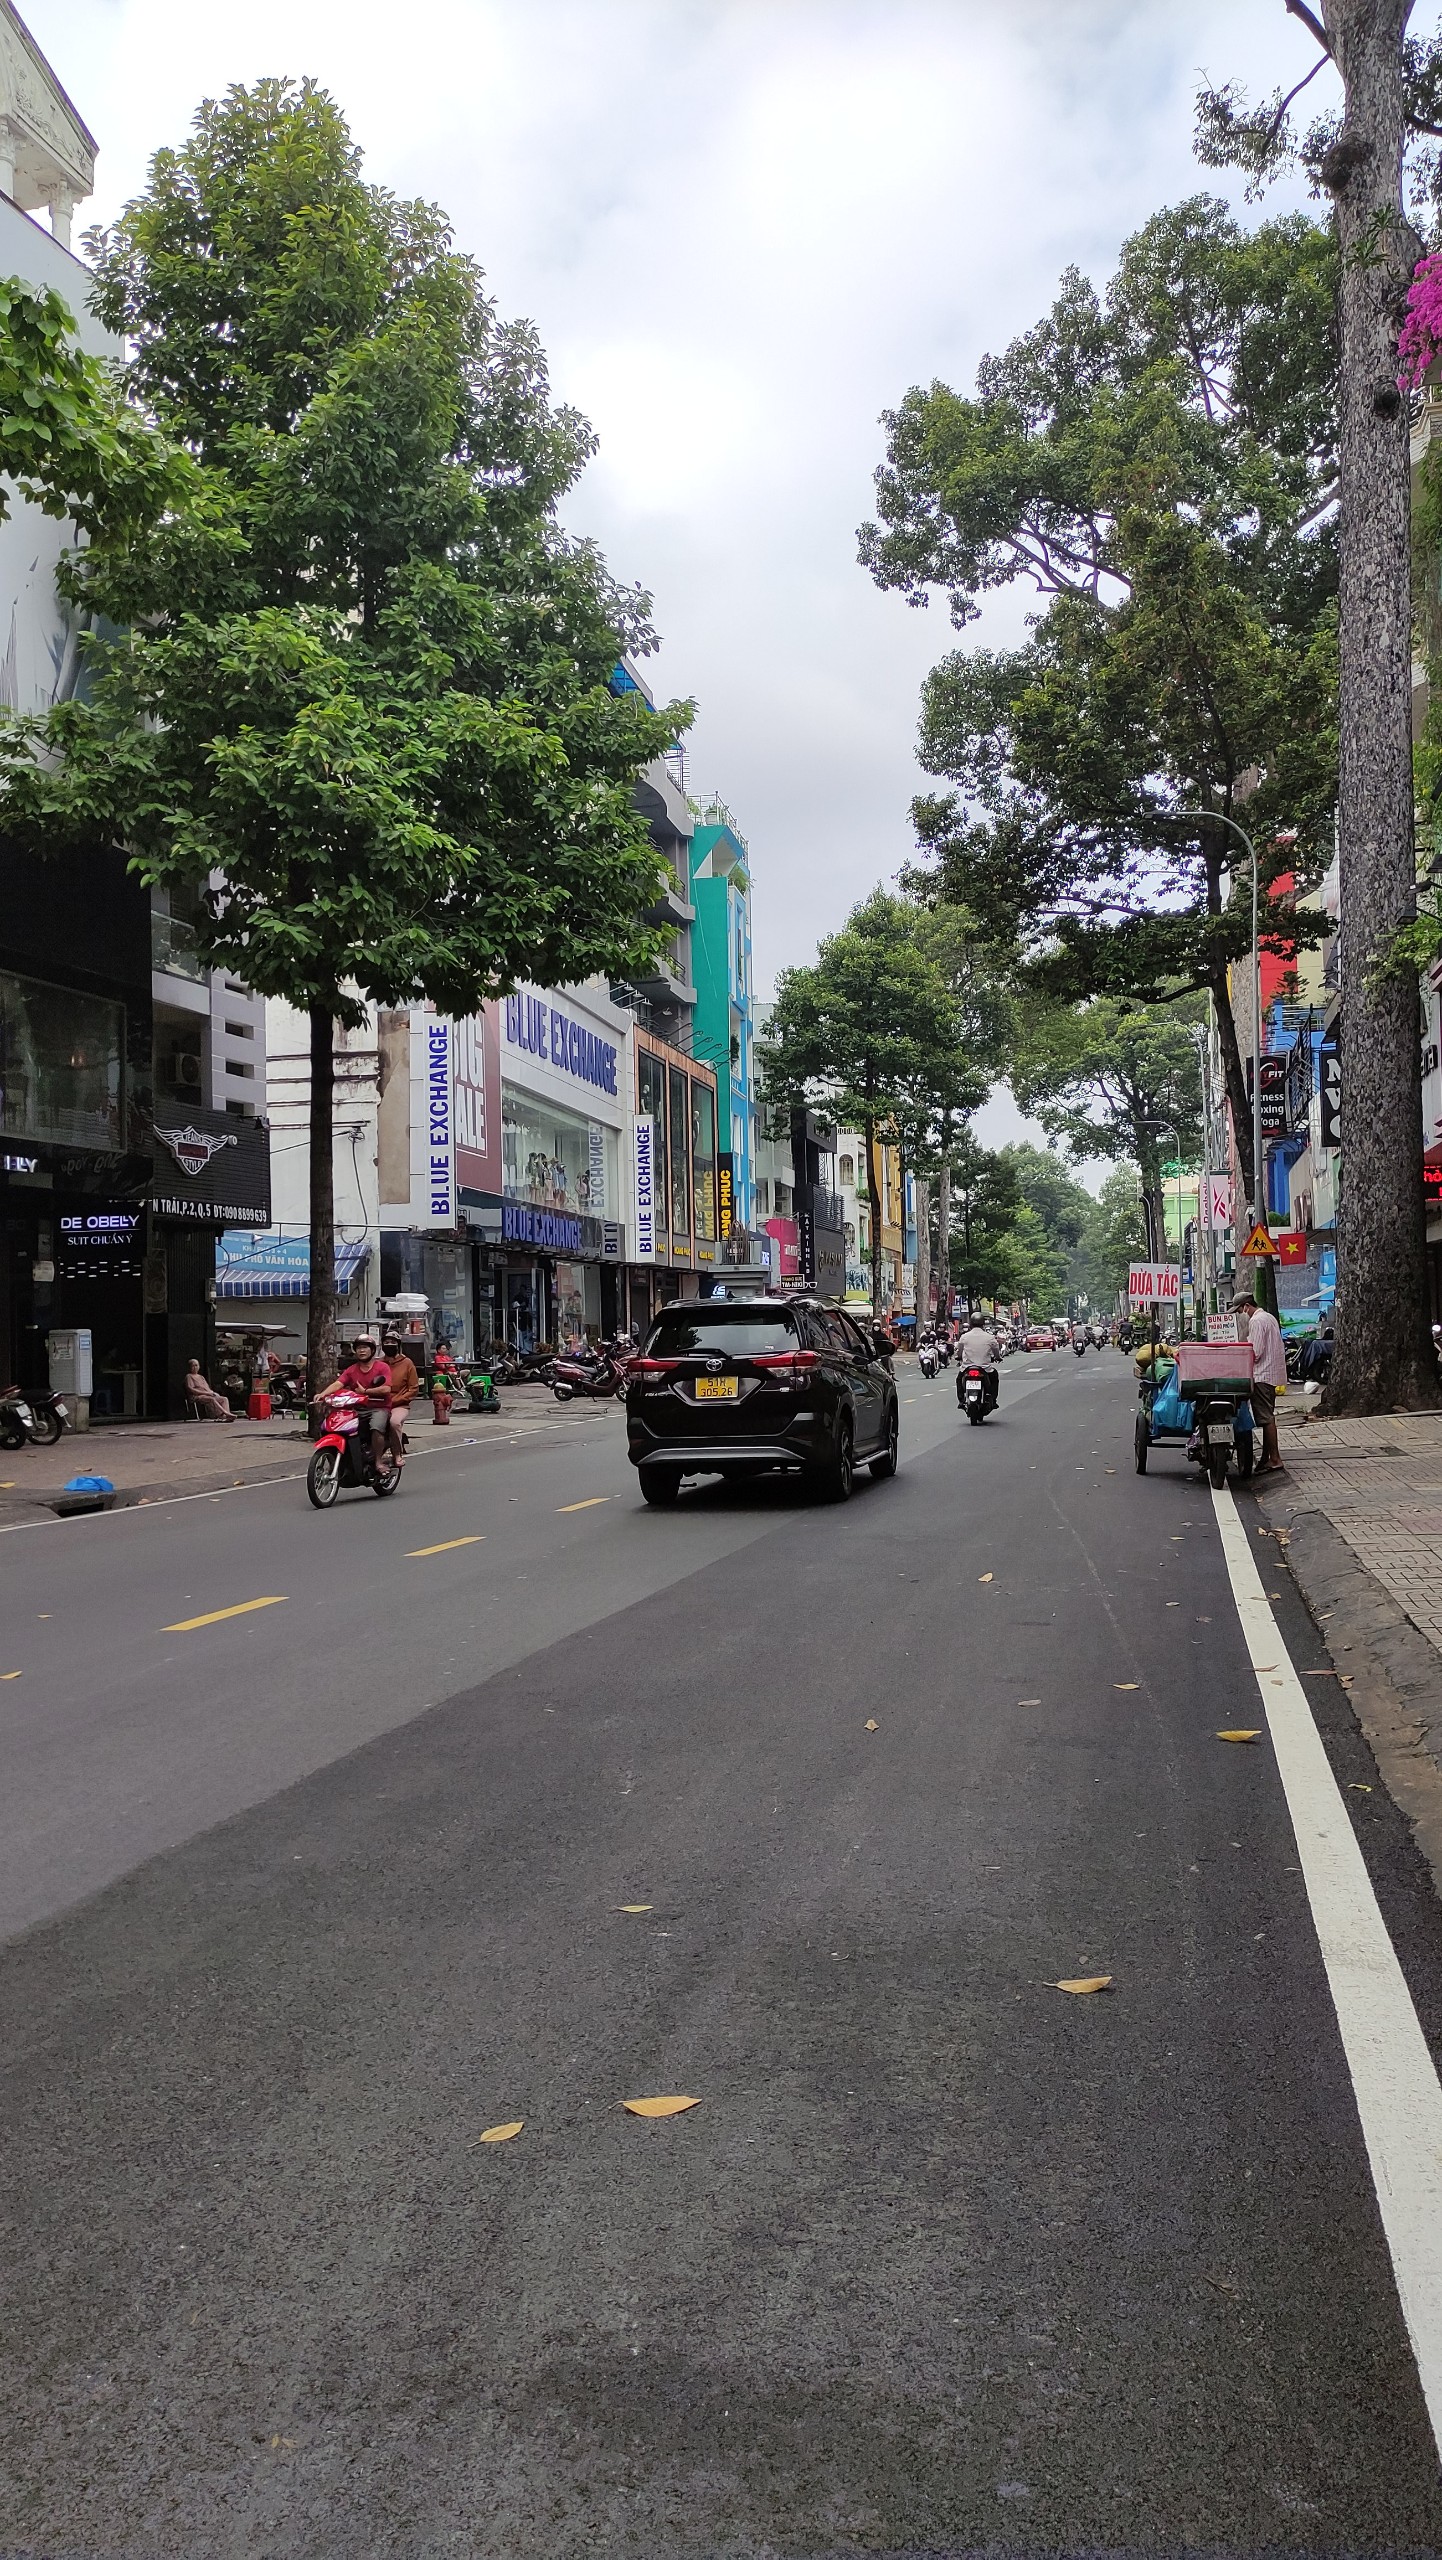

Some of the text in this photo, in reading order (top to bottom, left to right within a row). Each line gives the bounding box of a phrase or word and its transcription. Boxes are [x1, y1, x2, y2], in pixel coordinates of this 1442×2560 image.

[506, 989, 617, 1097] BLUE EXCHANGE
[429, 1024, 450, 1215] BLUE EXCHANGE
[456, 1083, 486, 1151] ALE
[637, 1124, 652, 1253] BLUE EXCHANGE
[720, 1169, 731, 1239] ANG PHUC
[60, 1215, 140, 1229] DE OBELLY
[67, 1236, 90, 1246] SUIT
[505, 1206, 582, 1251] BLUE EXCHANGE
[265, 1254, 285, 1265] VĂN
[1130, 1265, 1179, 1297] DỪA TẮC
[700, 1387, 733, 1397] 305.26
[707, 1377, 726, 1387] 51H
